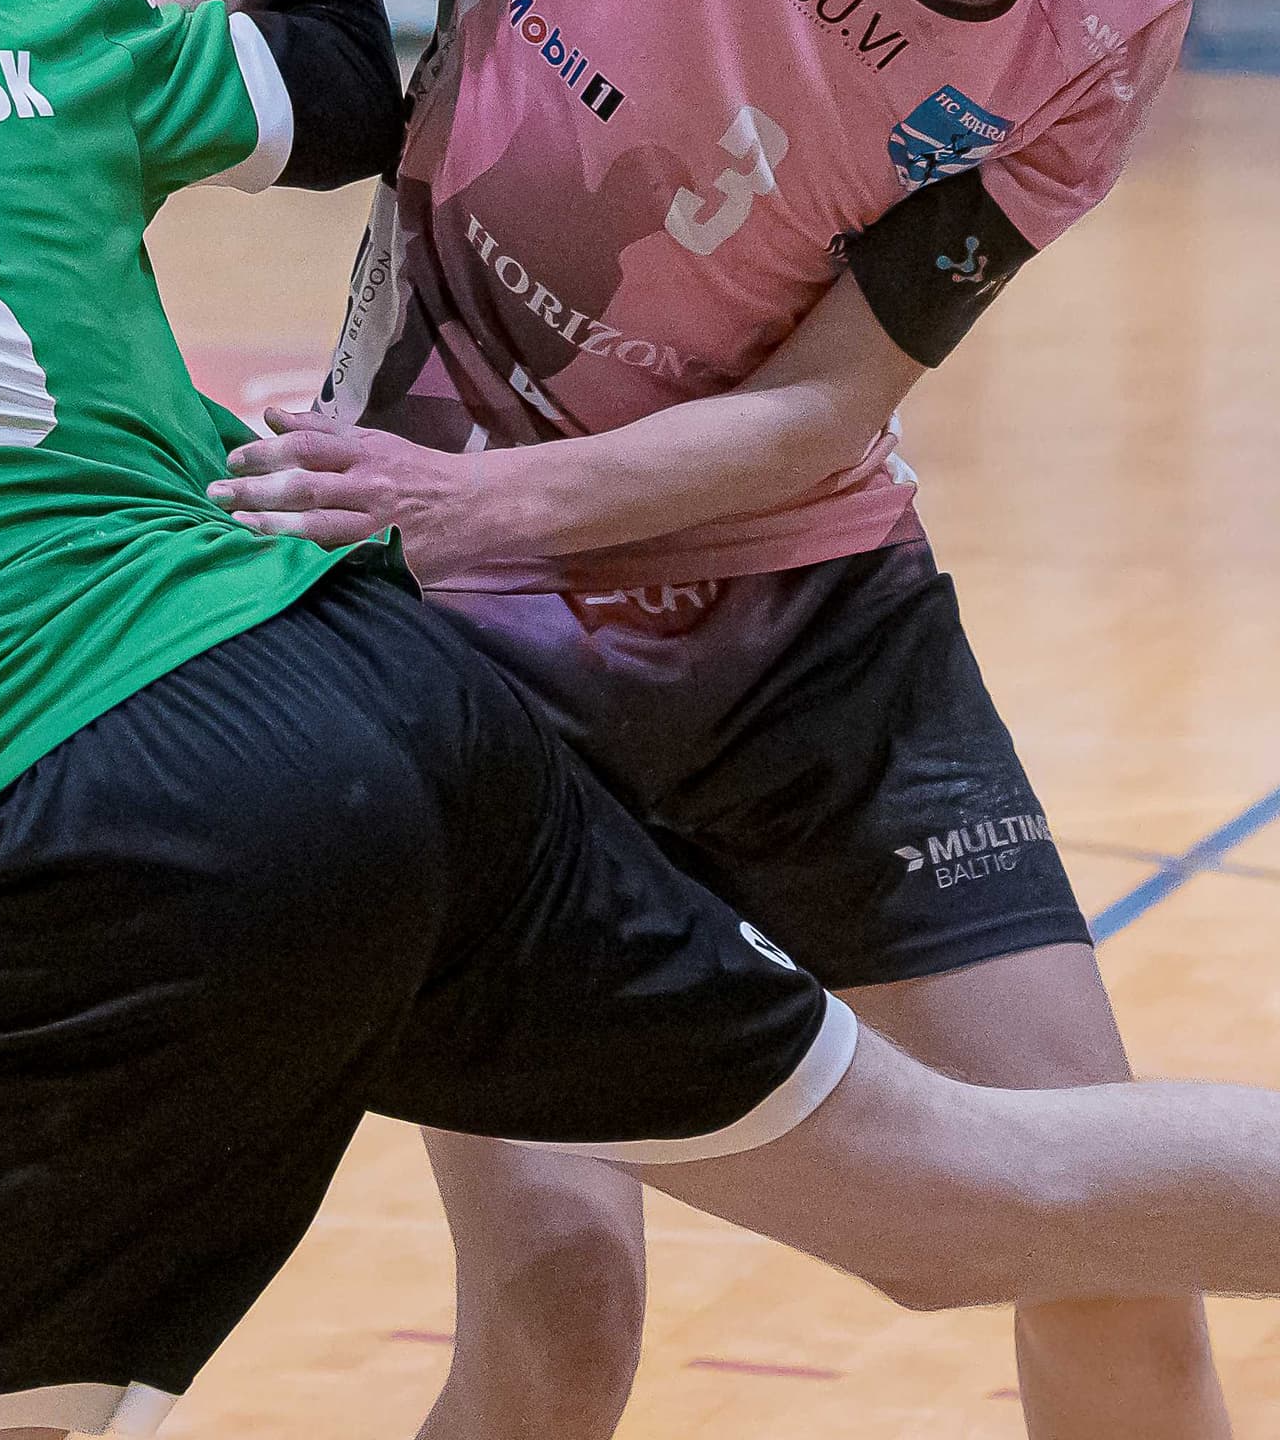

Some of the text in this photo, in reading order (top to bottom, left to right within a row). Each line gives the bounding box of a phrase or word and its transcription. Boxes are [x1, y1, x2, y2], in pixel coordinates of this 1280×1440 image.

[664, 106, 790, 256] 3
[347, 249, 393, 342] BETOON
[464, 213, 683, 378] HORIZON
[927, 814, 1053, 865] MULTIM
[935, 847, 1021, 889] BALTIC
